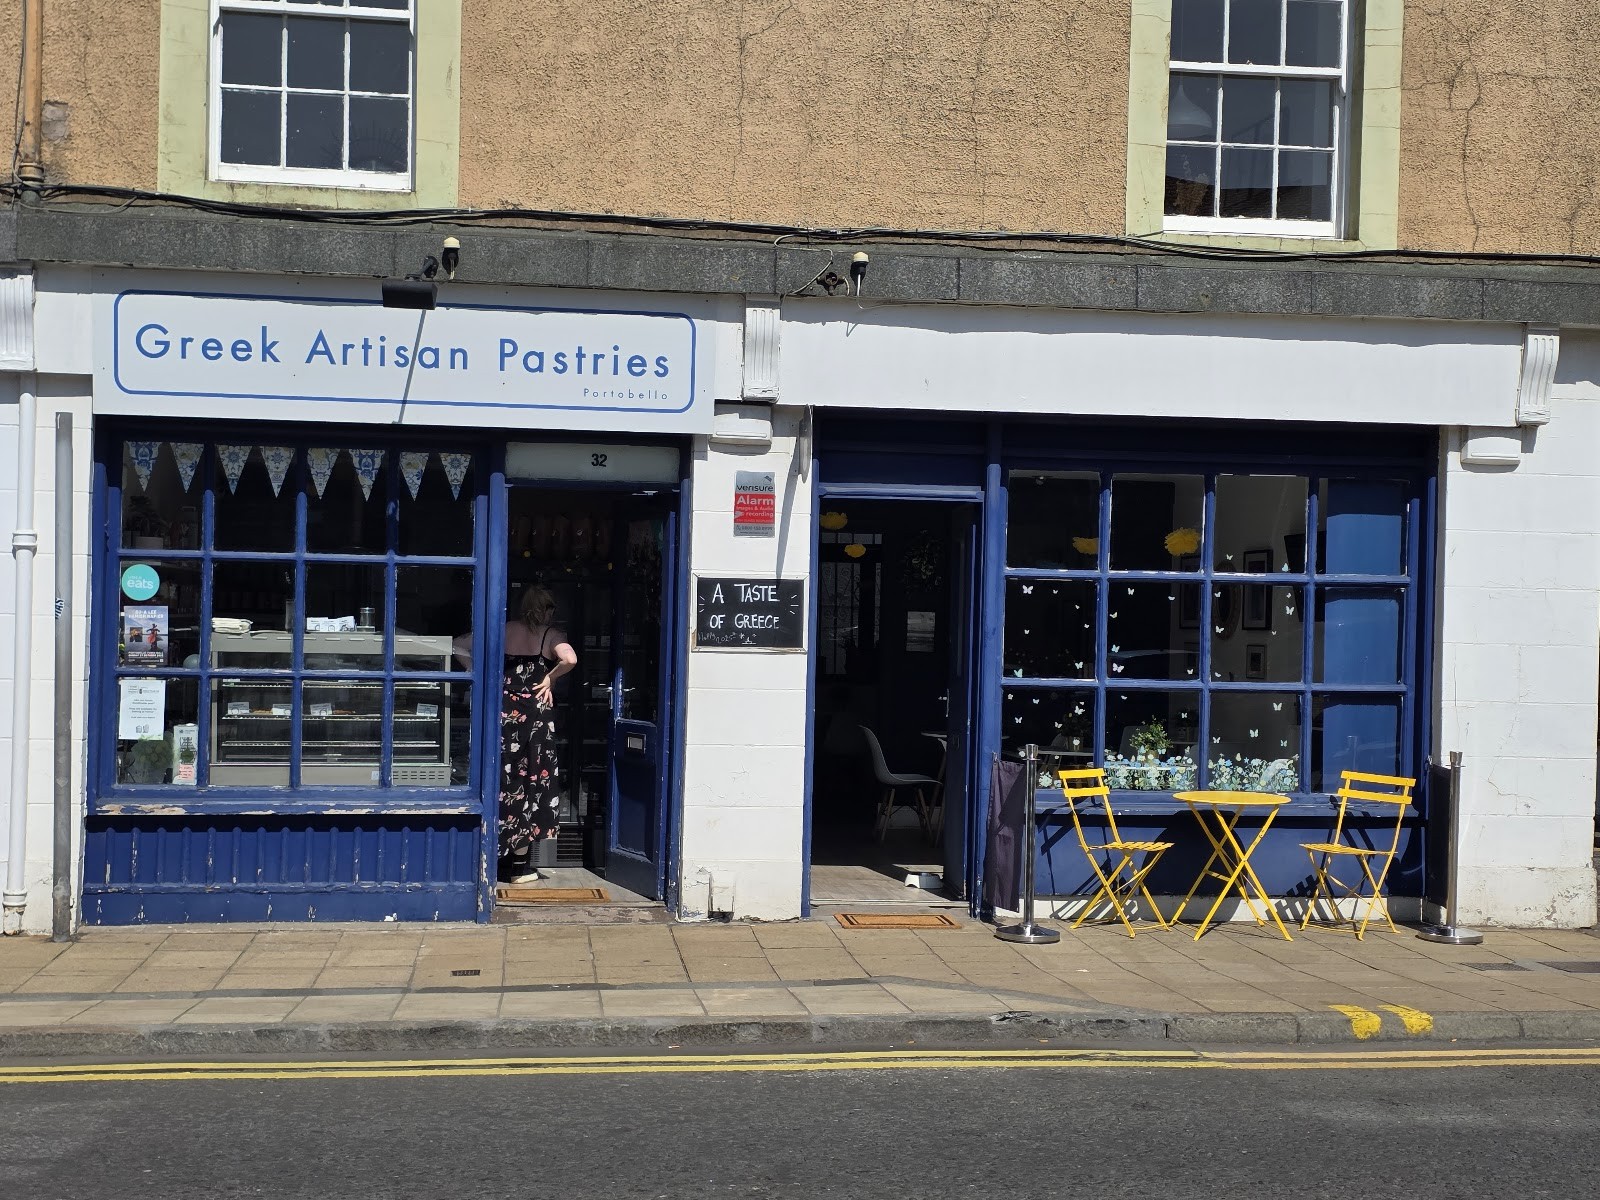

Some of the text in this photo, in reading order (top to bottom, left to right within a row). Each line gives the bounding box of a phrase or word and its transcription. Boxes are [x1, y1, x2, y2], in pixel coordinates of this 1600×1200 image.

[135, 323, 670, 378] Greek Artisan Pastries
[584, 388, 668, 400] Portobello
[591, 453, 608, 468] 32
[736, 495, 774, 505] Alarm
[127, 579, 154, 590] eats
[712, 582, 780, 604] A TASTE
[709, 613, 780, 630] OF GREECE
